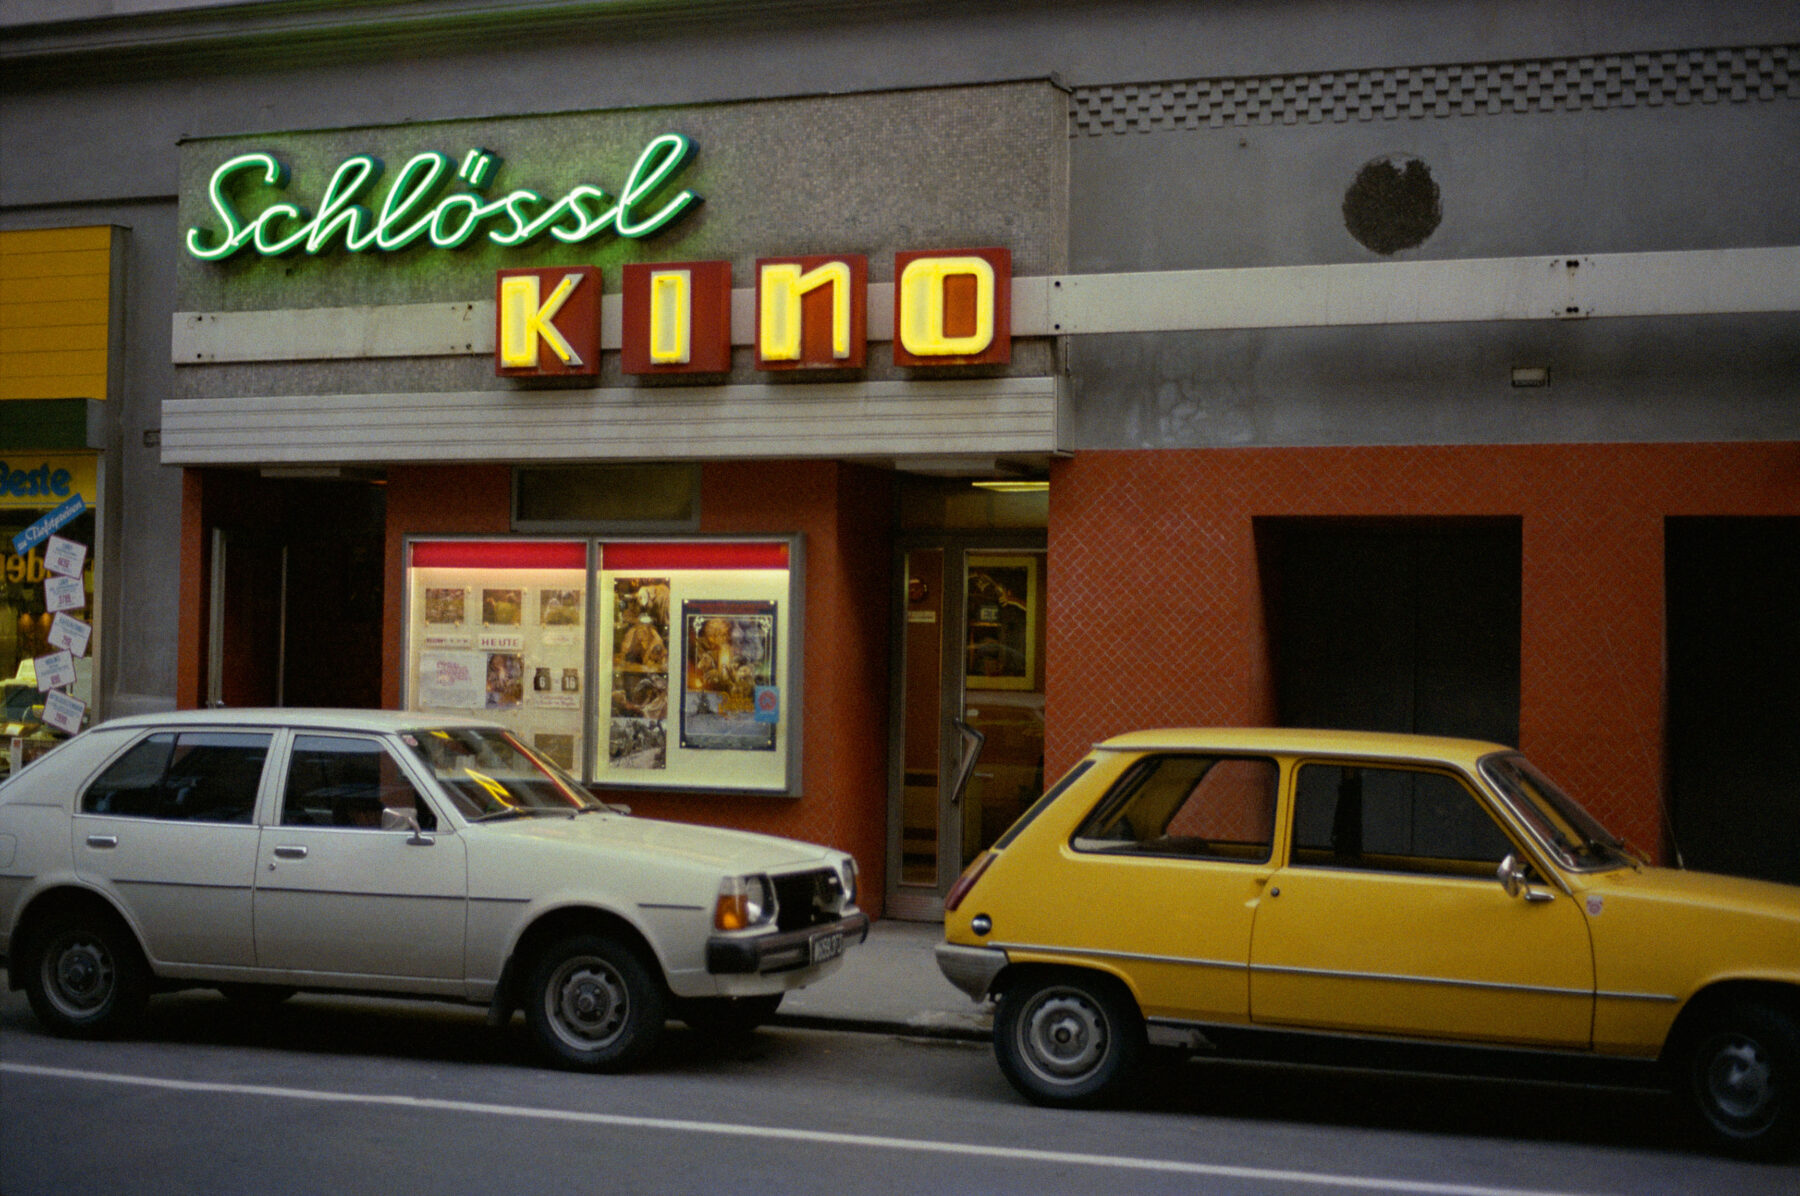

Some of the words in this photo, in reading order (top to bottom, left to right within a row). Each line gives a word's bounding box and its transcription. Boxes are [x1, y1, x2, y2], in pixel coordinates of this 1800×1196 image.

[187, 133, 696, 260] Schlössl
[481, 638, 519, 648] HEUTE
[539, 676, 546, 688] 6
[565, 676, 576, 689] 16
